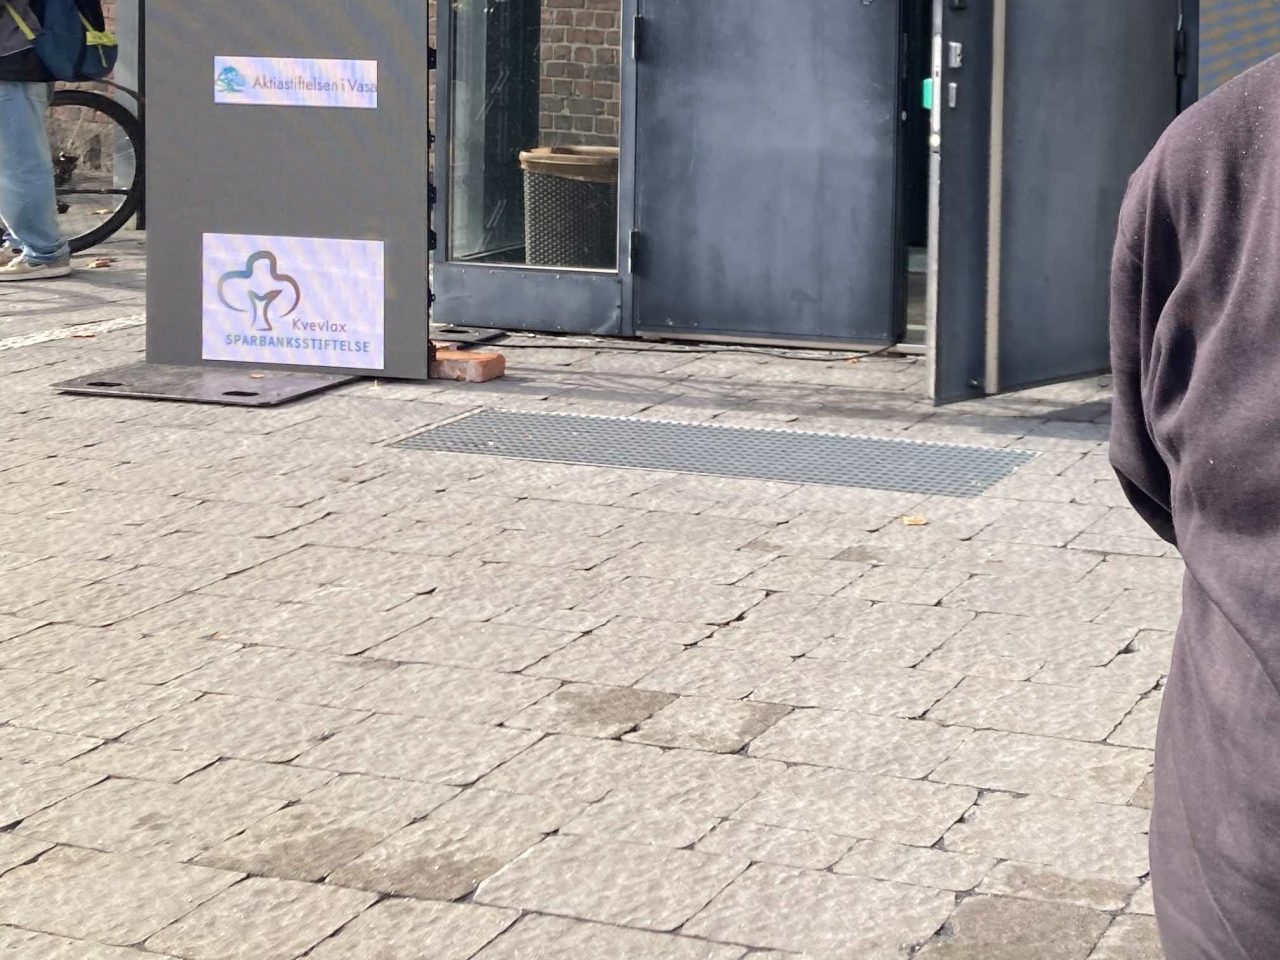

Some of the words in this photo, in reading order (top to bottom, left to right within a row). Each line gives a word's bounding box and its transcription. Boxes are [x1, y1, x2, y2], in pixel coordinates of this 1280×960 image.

[252, 74, 338, 91] Aktiastiftelsen
[347, 79, 377, 93] Vasa
[292, 318, 347, 333] Kvevlax
[225, 334, 371, 353] SPARBANKSSTIFTELSE
